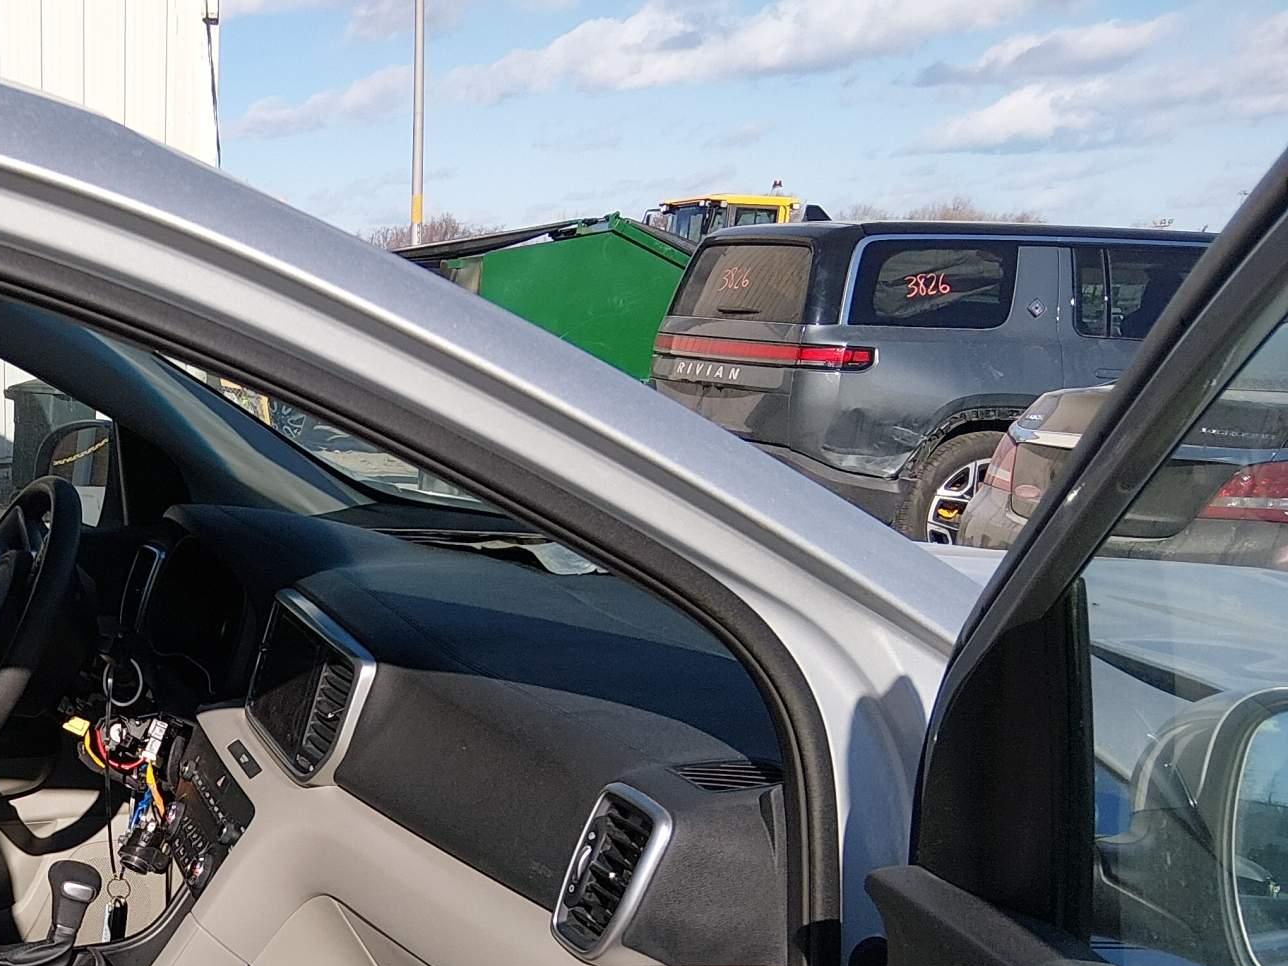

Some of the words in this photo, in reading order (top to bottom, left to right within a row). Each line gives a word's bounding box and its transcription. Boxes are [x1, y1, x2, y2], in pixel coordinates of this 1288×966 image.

[718, 266, 752, 292] 3826
[904, 272, 951, 298] 3826
[676, 361, 741, 380] RIVIAN
